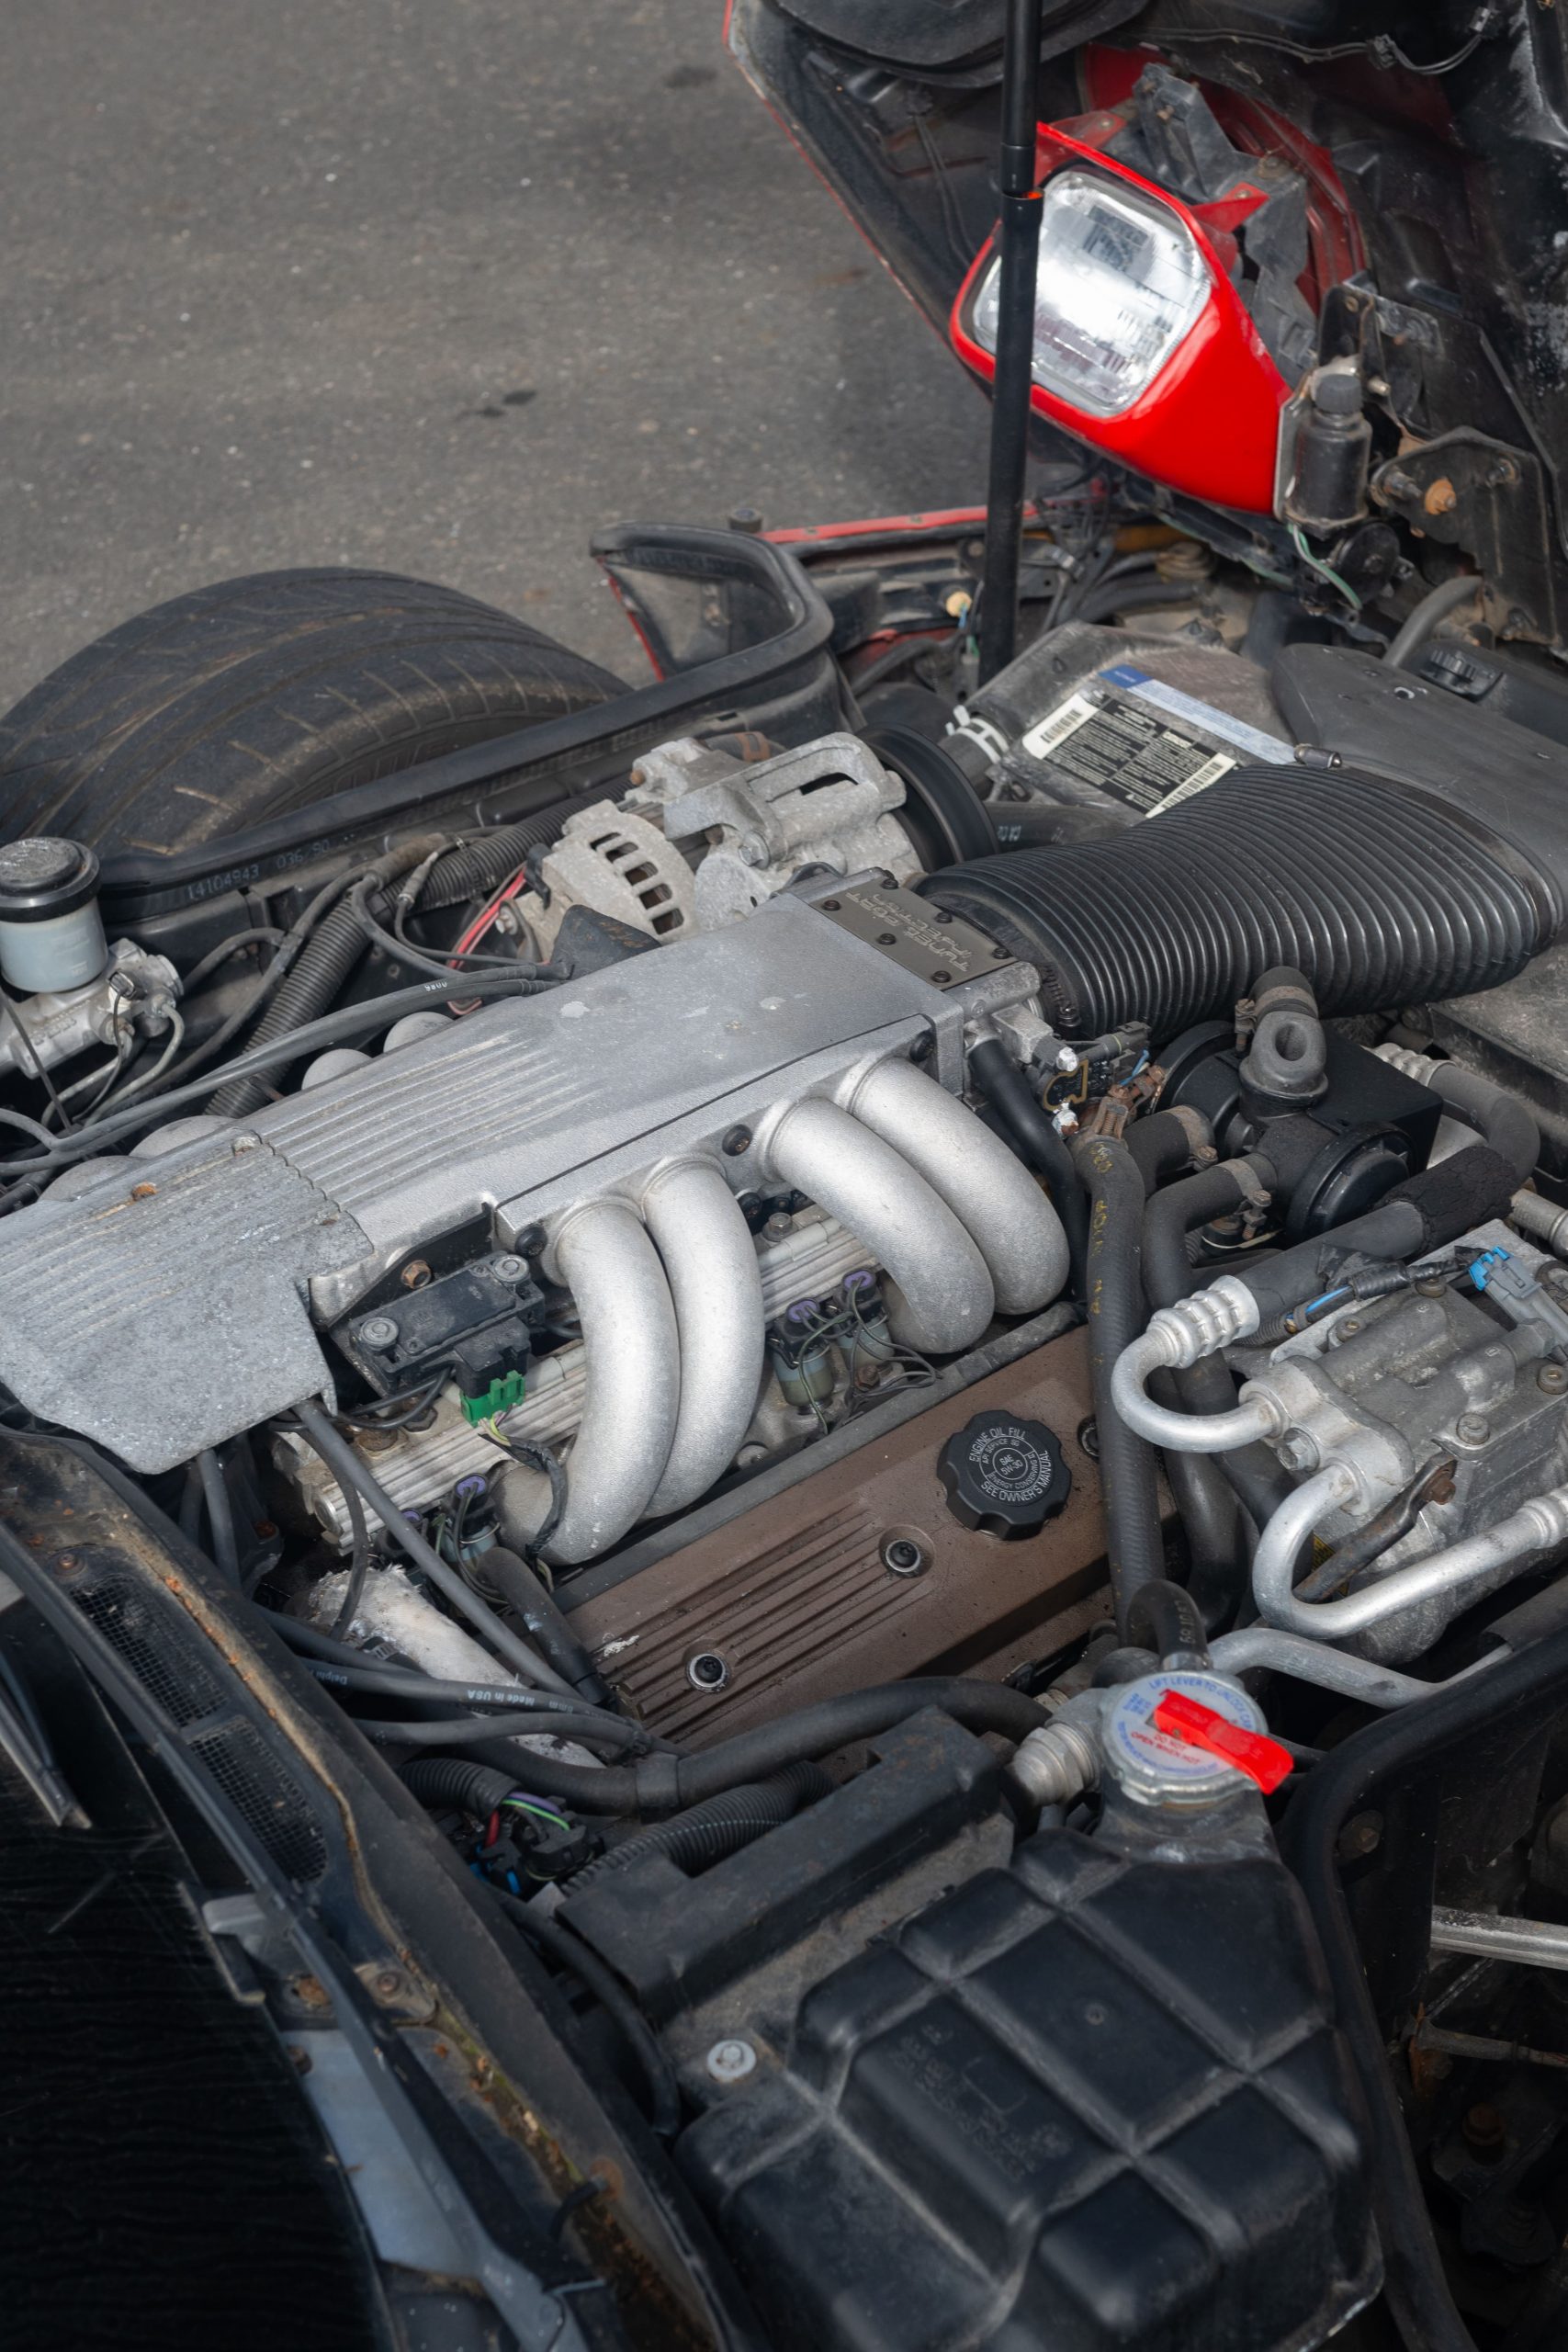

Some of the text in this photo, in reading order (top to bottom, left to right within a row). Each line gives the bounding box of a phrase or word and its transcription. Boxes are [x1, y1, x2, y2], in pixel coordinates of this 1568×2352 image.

[845, 892, 970, 972] TUNED PORT
[969, 1427, 1026, 1463] ENGINE OIL FILL
[985, 1438, 1009, 1453] SERVICE
[982, 1453, 990, 1464] API
[999, 1454, 1014, 1466] SAE
[988, 1472, 1013, 1488] ENERGY
[1014, 1459, 1038, 1489] CONSERVING
[1000, 1459, 1023, 1476] 5W-30
[981, 1450, 1052, 1502] SEE OWNER'S MANUAL
[315, 1668, 348, 1685] Delphi
[1149, 1677, 1168, 1690] LIFT
[1171, 1677, 1203, 1687] LEVER
[1204, 1681, 1218, 1692] TO
[467, 1689, 491, 1701] USA
[495, 1692, 505, 1702] in
[507, 1694, 536, 1706] Made
[1131, 1731, 1154, 1746] OPEN
